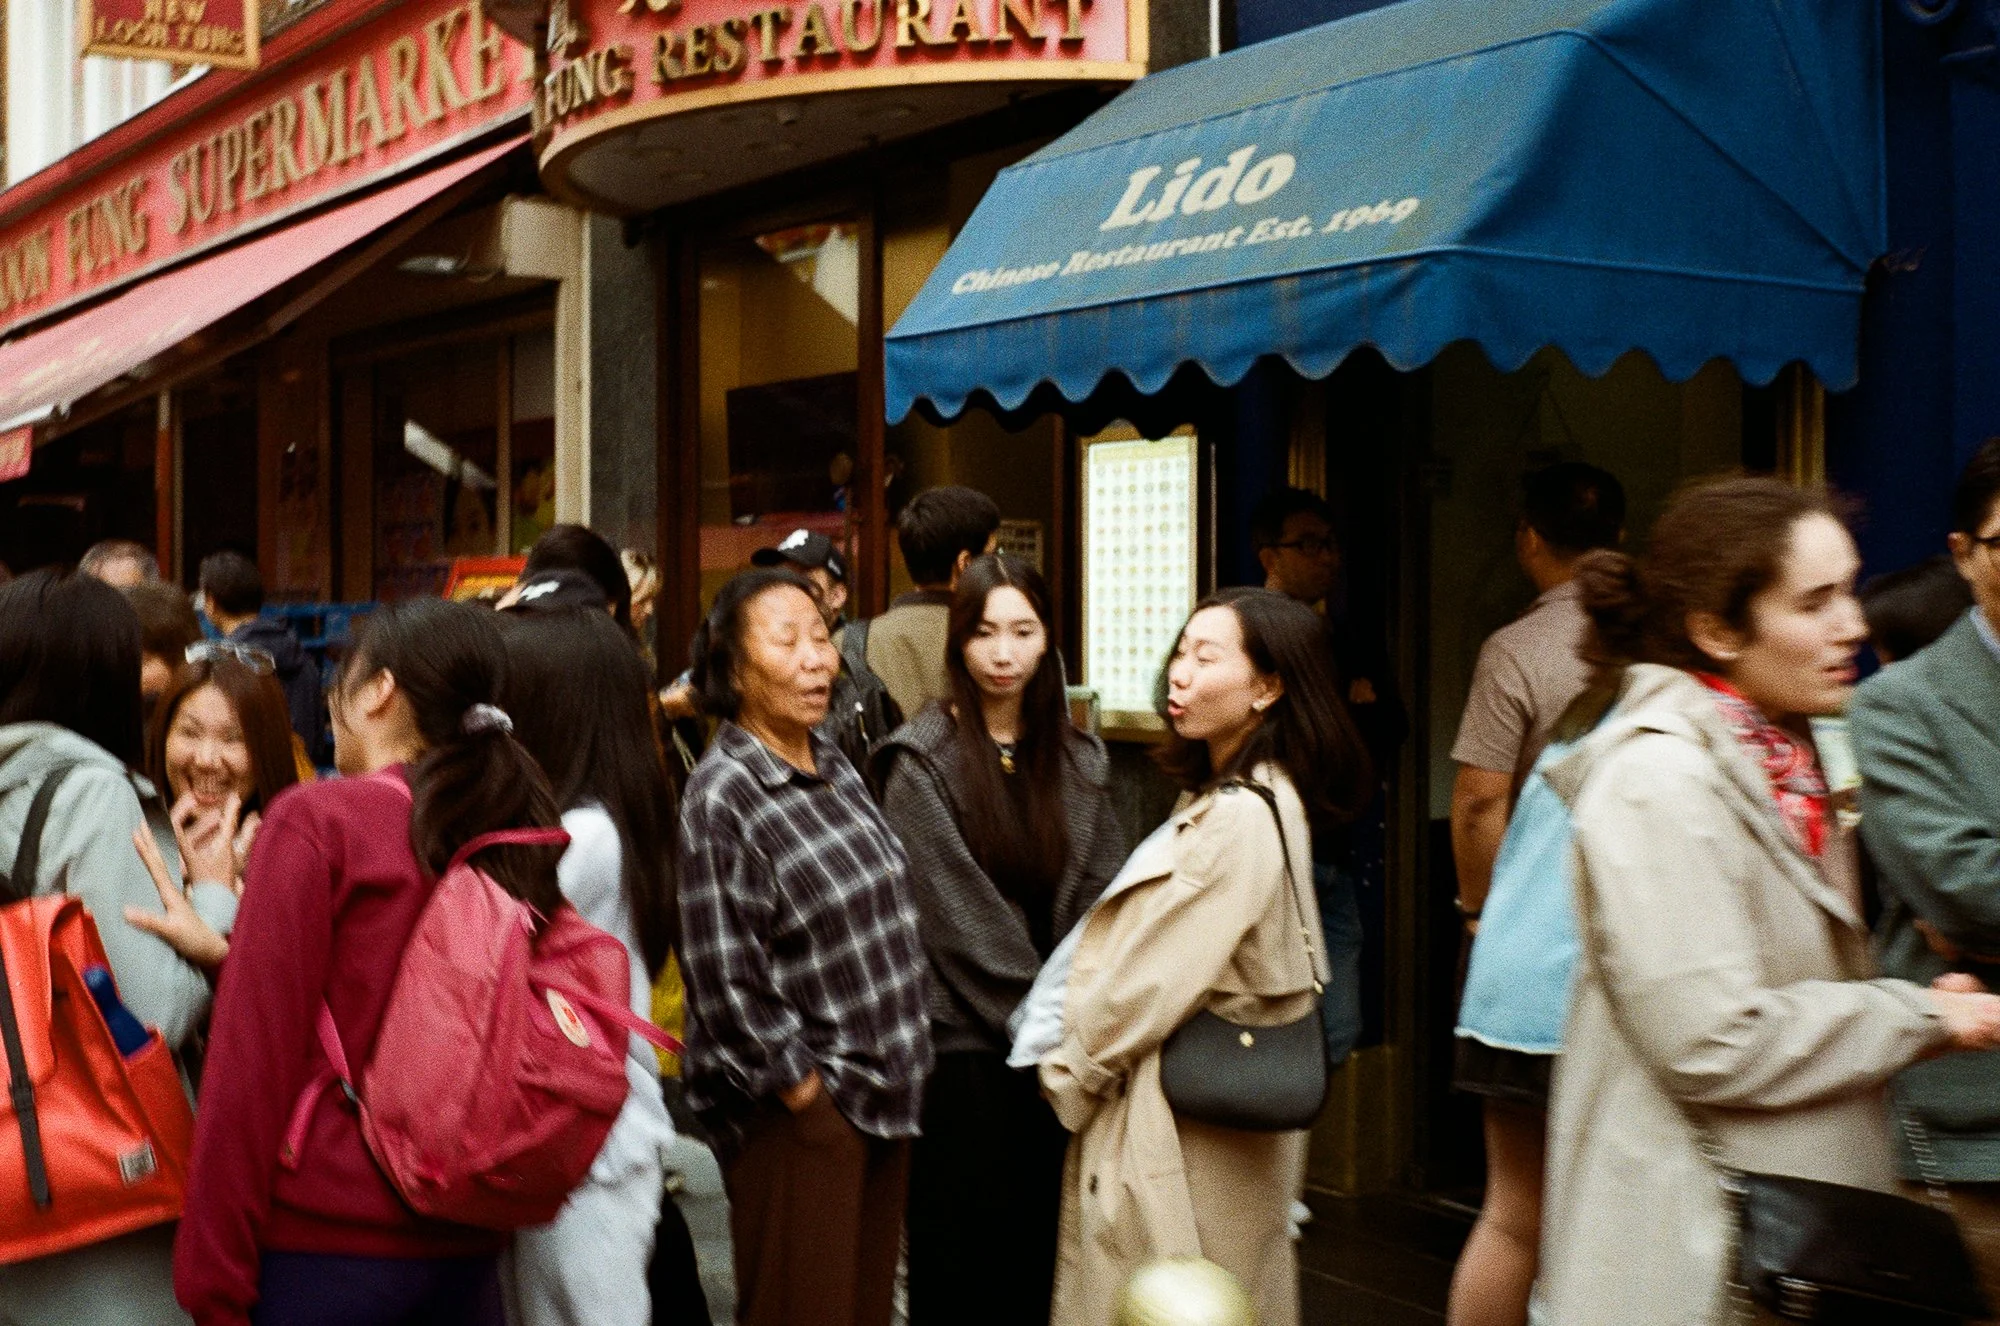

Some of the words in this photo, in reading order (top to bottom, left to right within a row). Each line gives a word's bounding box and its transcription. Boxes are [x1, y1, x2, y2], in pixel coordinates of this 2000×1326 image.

[543, 44, 634, 125] FUNG
[652, 0, 1086, 84] RESTAURANT
[66, 175, 148, 283] FUNG
[1100, 144, 1297, 232] Lido
[951, 260, 1062, 295] Chinese
[1059, 224, 1245, 276] Restaurant
[1243, 214, 1313, 246] Est.
[1320, 196, 1421, 235] 1969
